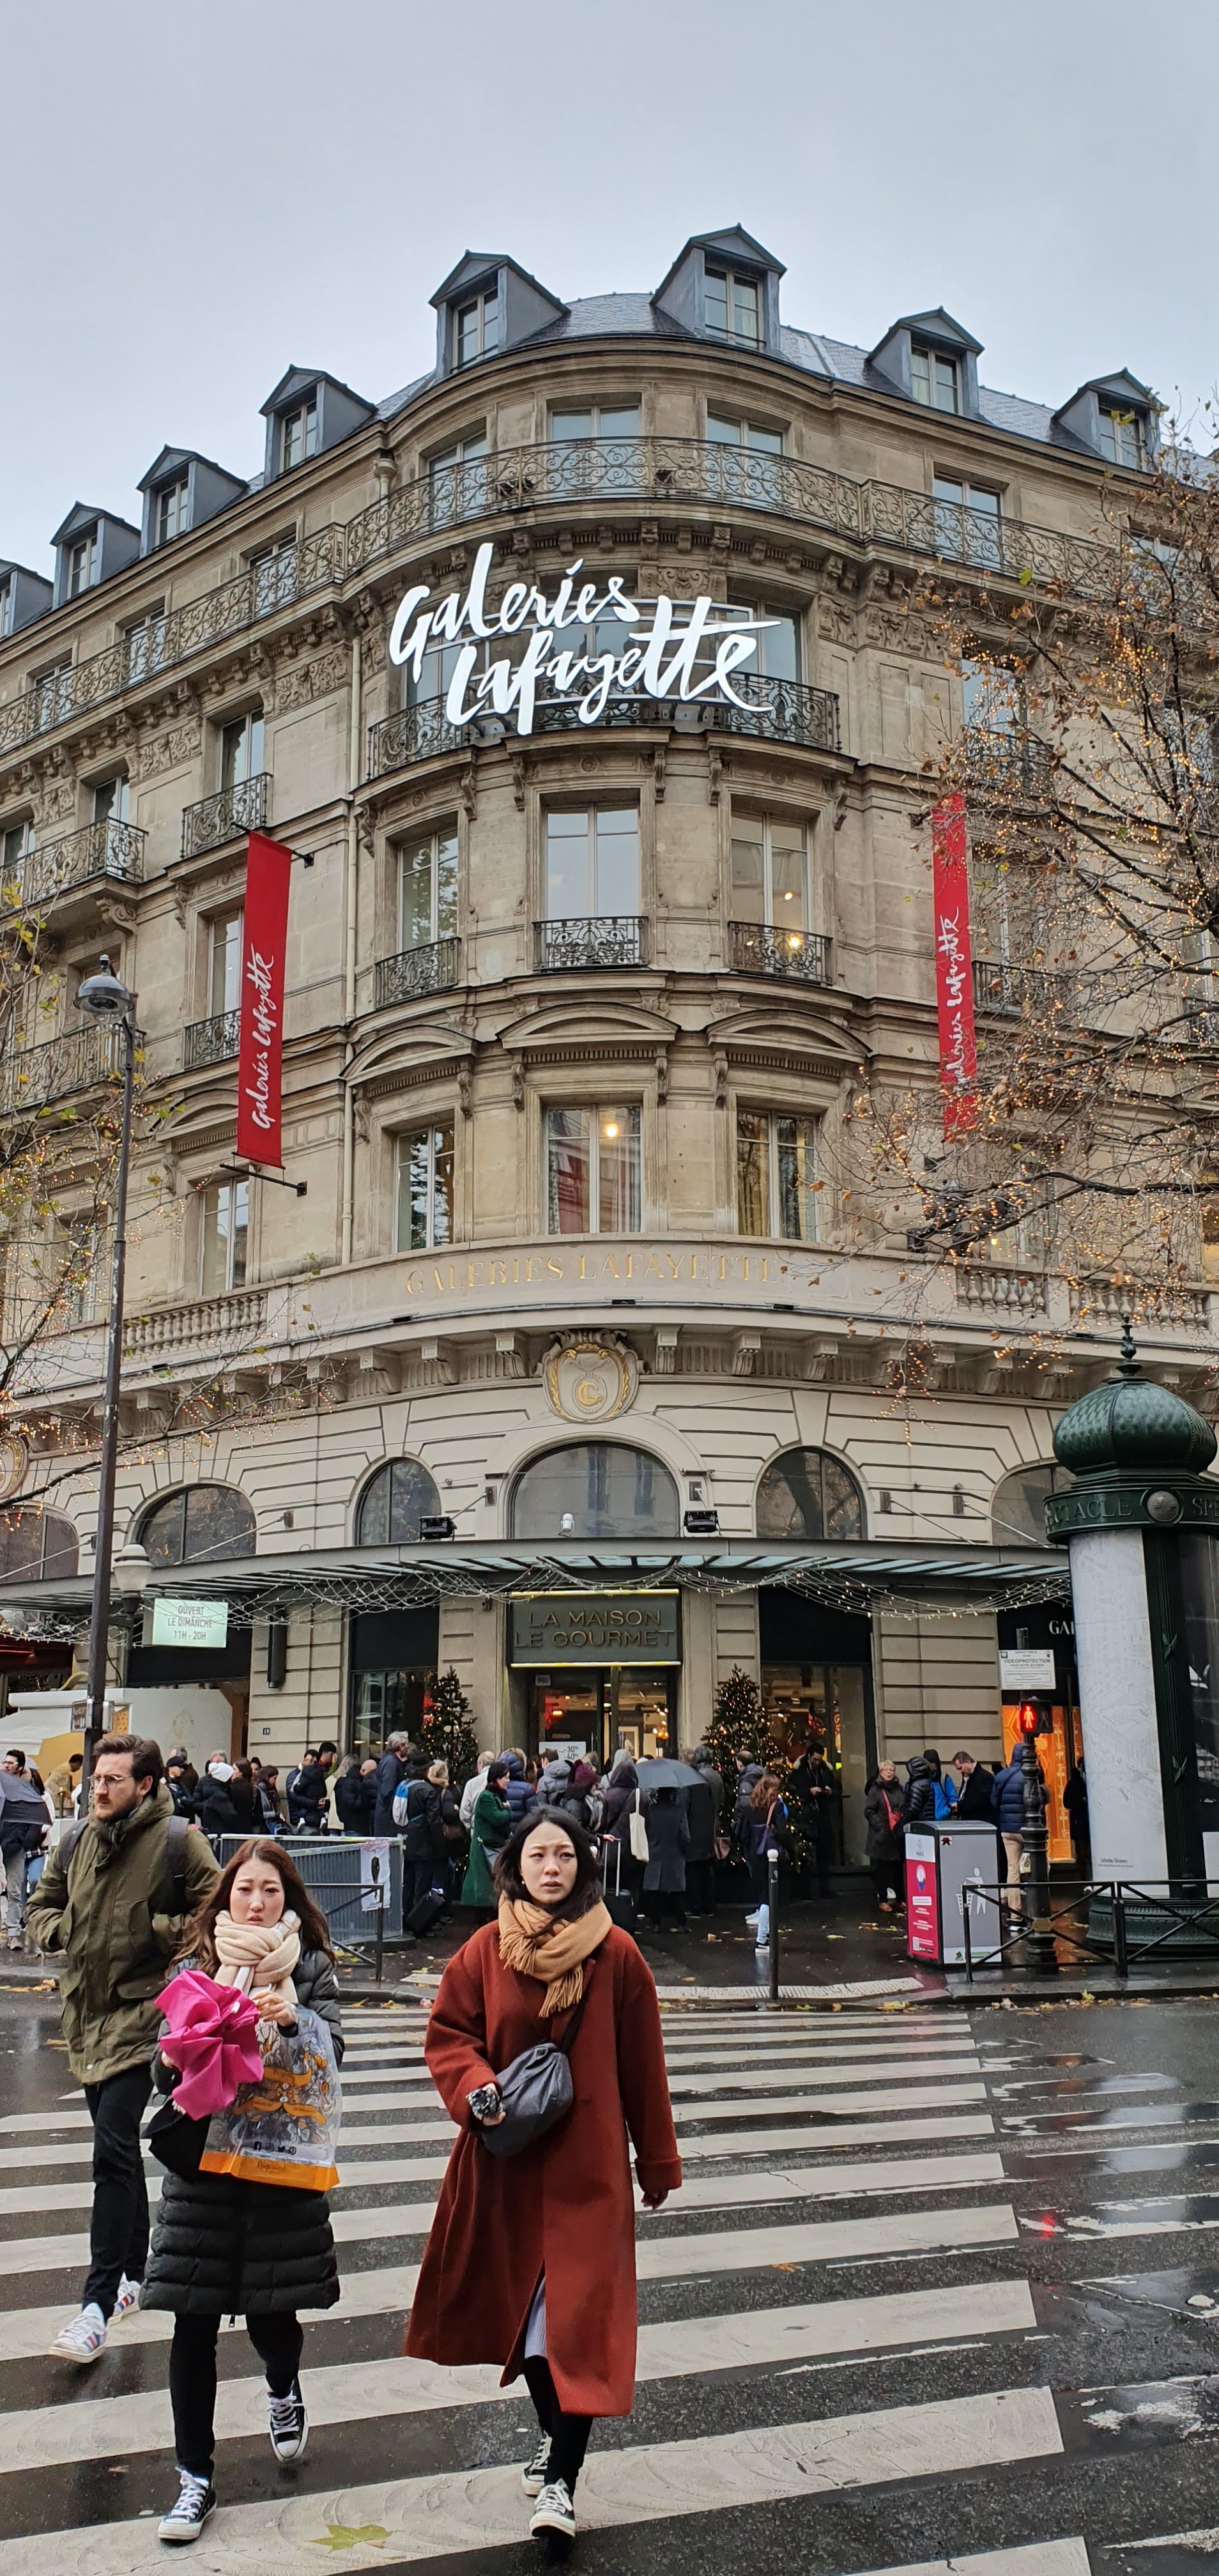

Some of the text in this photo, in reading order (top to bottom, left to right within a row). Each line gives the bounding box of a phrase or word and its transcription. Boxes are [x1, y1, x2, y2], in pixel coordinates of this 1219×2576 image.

[388, 542, 640, 684] Galeries
[446, 595, 782, 735] Lafayette
[245, 942, 277, 1129] Galeries Lafayette
[406, 1254, 778, 1295] GALERIES LAFAYETTE
[178, 1605, 205, 1616] OUVERT
[529, 1609, 661, 1627] LA MAISON
[167, 1617, 213, 1629] LE DIMANCHE
[174, 1630, 187, 1639] 11H
[192, 1630, 206, 1641] 20H
[514, 1630, 675, 1648] LE GOURMET
